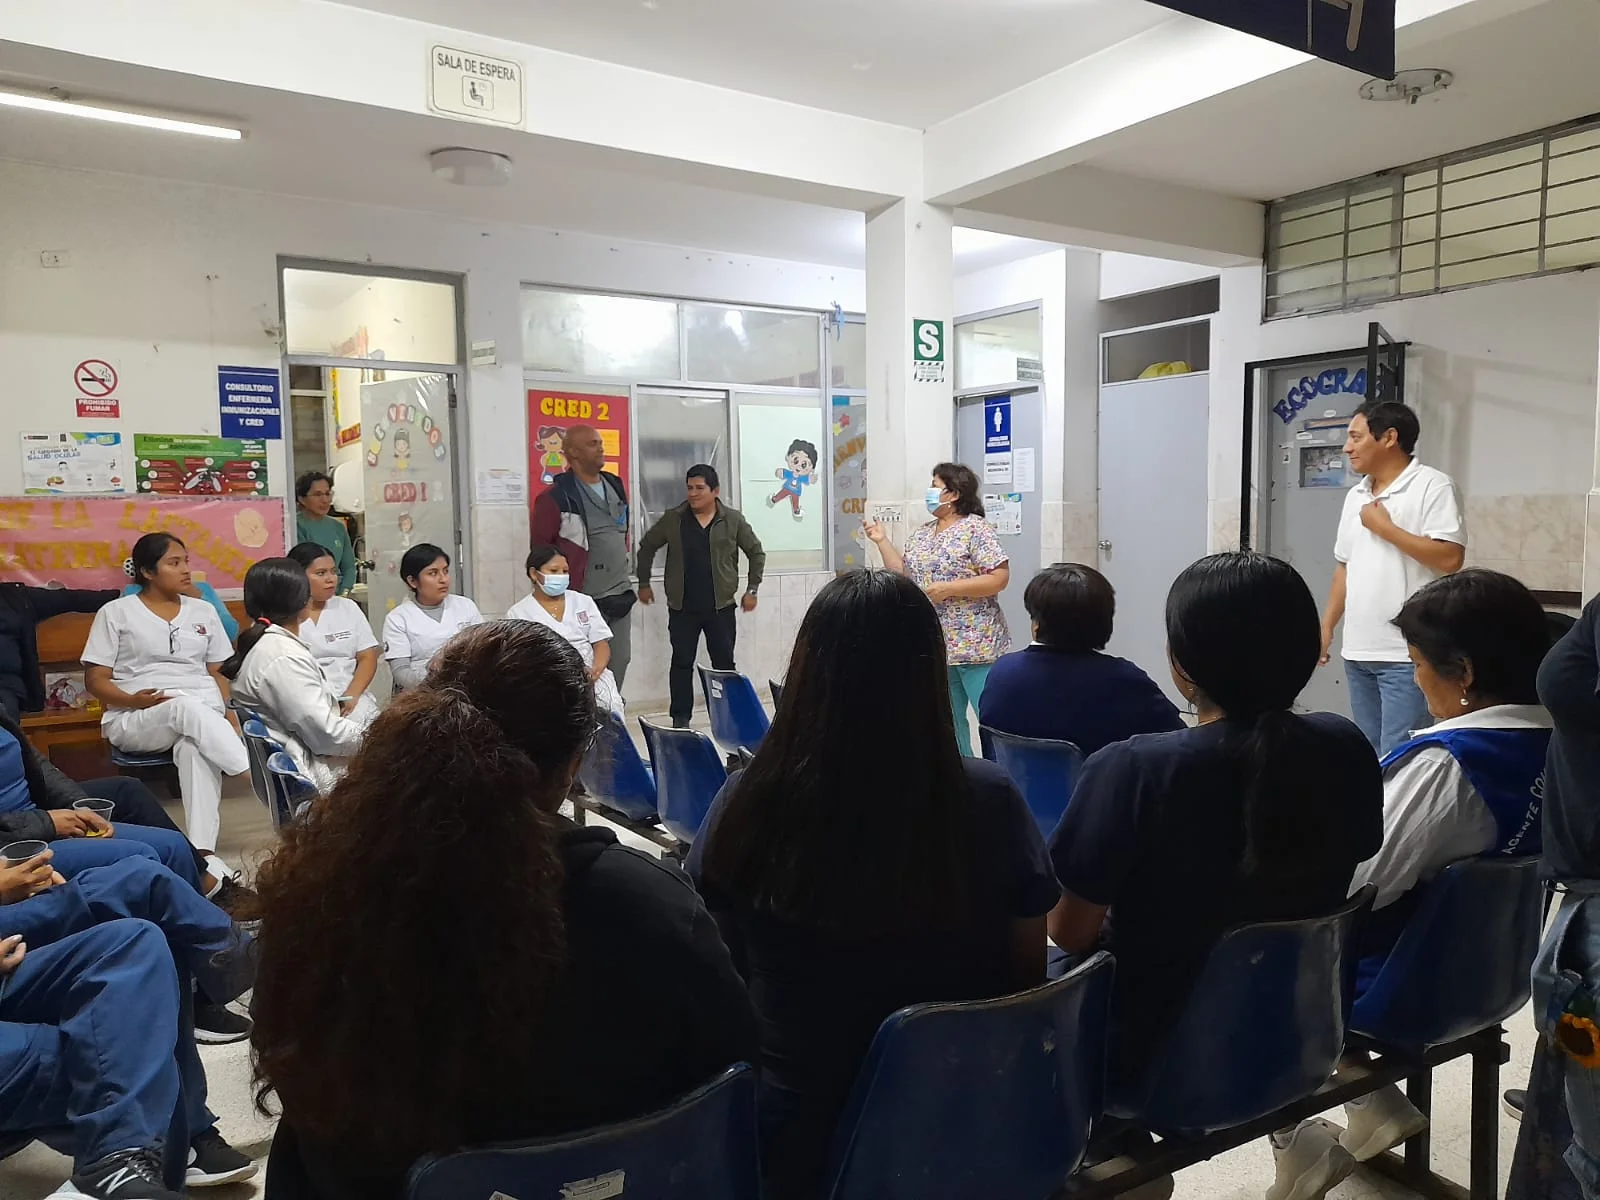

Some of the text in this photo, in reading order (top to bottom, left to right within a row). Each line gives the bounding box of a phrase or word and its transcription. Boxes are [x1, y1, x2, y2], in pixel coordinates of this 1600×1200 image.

[437, 53, 516, 81] SALA DE ESPERA
[918, 322, 940, 358] S
[225, 383, 274, 392] CONSULTORIO
[228, 394, 272, 404] ENFERMERIA
[1272, 367, 1367, 424] ECOGRA
[221, 406, 280, 415] INMUNIZACIONES
[245, 418, 264, 426] CRED
[540, 397, 609, 421] CRED 2
[51, 500, 95, 528] LA
[1501, 802, 1539, 855] AGENTE
